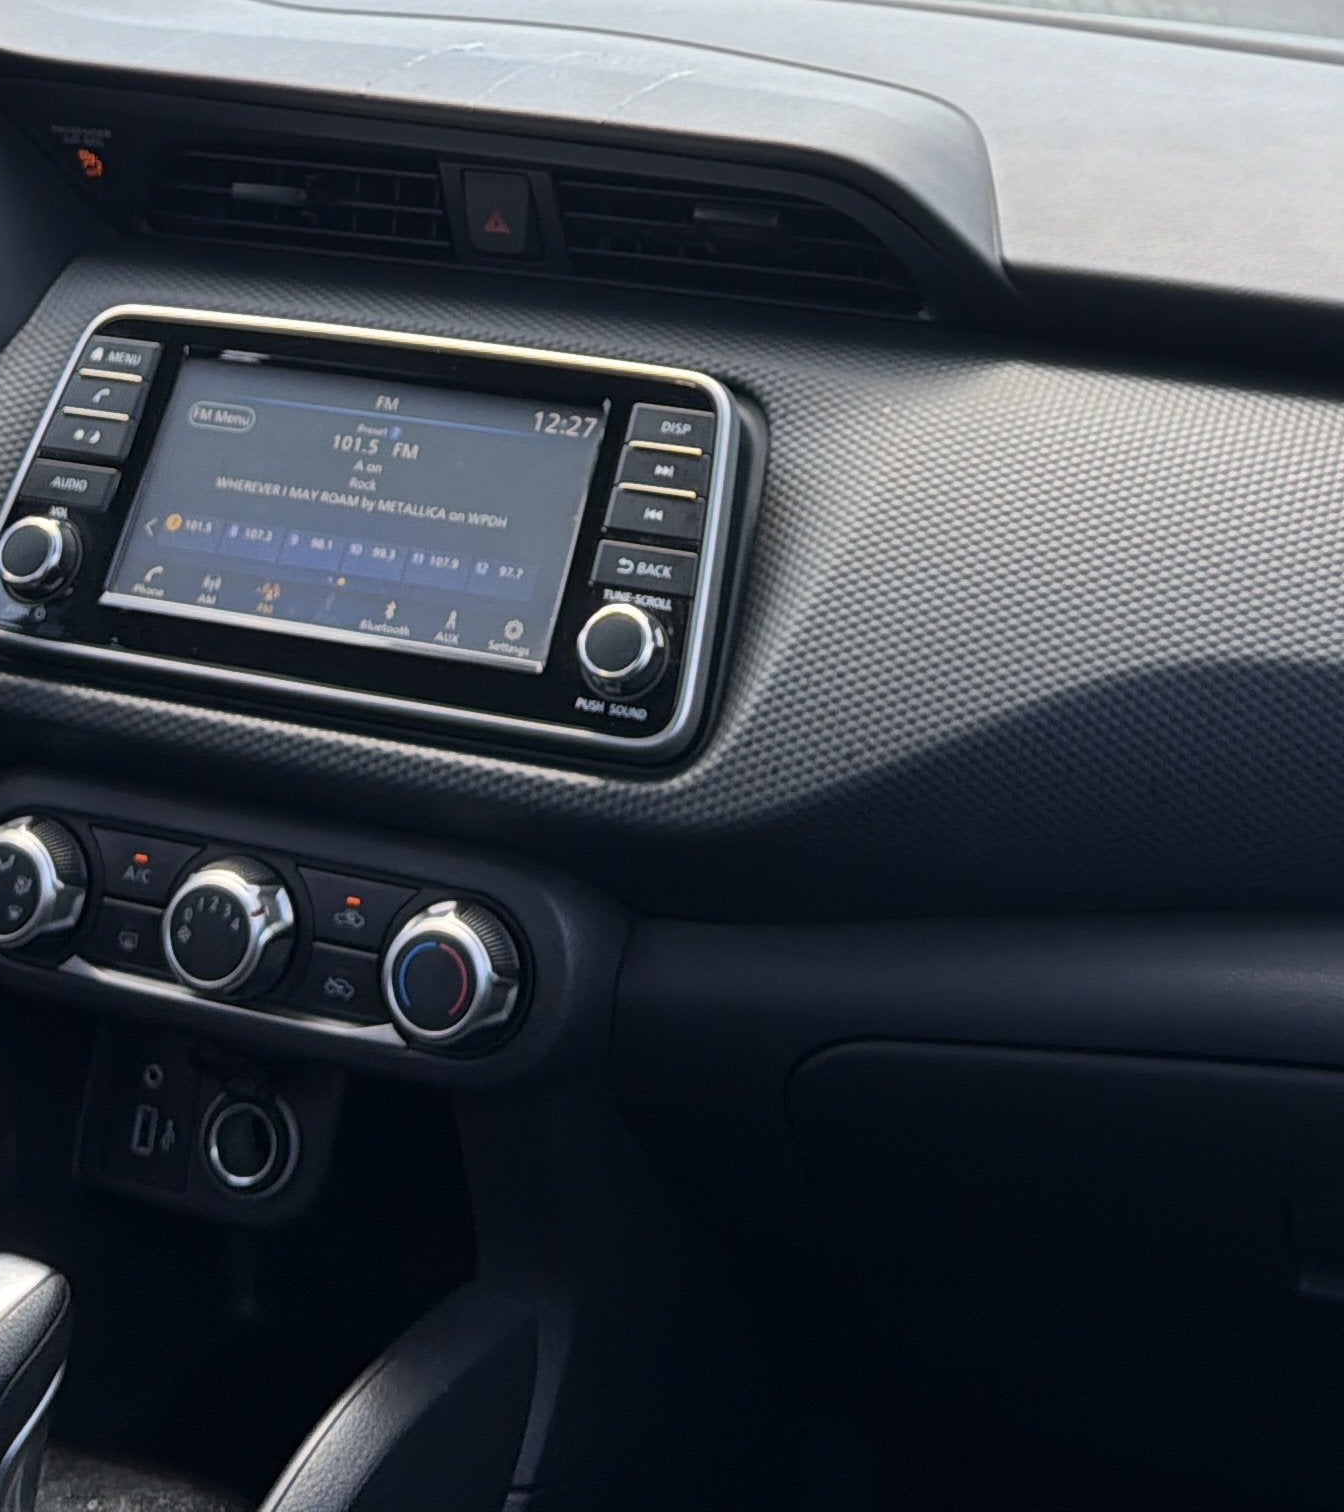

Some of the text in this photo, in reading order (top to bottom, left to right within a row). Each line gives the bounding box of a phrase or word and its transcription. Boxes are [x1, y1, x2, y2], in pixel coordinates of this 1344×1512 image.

[108, 349, 142, 366] MENU
[375, 395, 400, 412] FM
[192, 407, 251, 426] FM Menu
[533, 411, 599, 438] 12:27
[660, 420, 692, 436] DISP
[333, 434, 420, 460] 101.5 FM
[354, 459, 364, 473] A
[50, 475, 88, 493] AUDIO
[348, 477, 378, 492] Rock
[214, 476, 281, 497] WHEREVER
[288, 486, 320, 502] MAY
[320, 490, 359, 507] ROAM
[360, 496, 378, 513] by
[377, 499, 446, 520] METALLICA
[635, 561, 673, 579] BACK
[132, 582, 165, 598] Phone
[359, 618, 411, 637] Bluetooth
[433, 630, 460, 645] AUX
[487, 639, 531, 658] Settings
[575, 696, 649, 721] PUSH SOUND
[121, 864, 152, 884] A/C
[209, 895, 220, 913] 2
